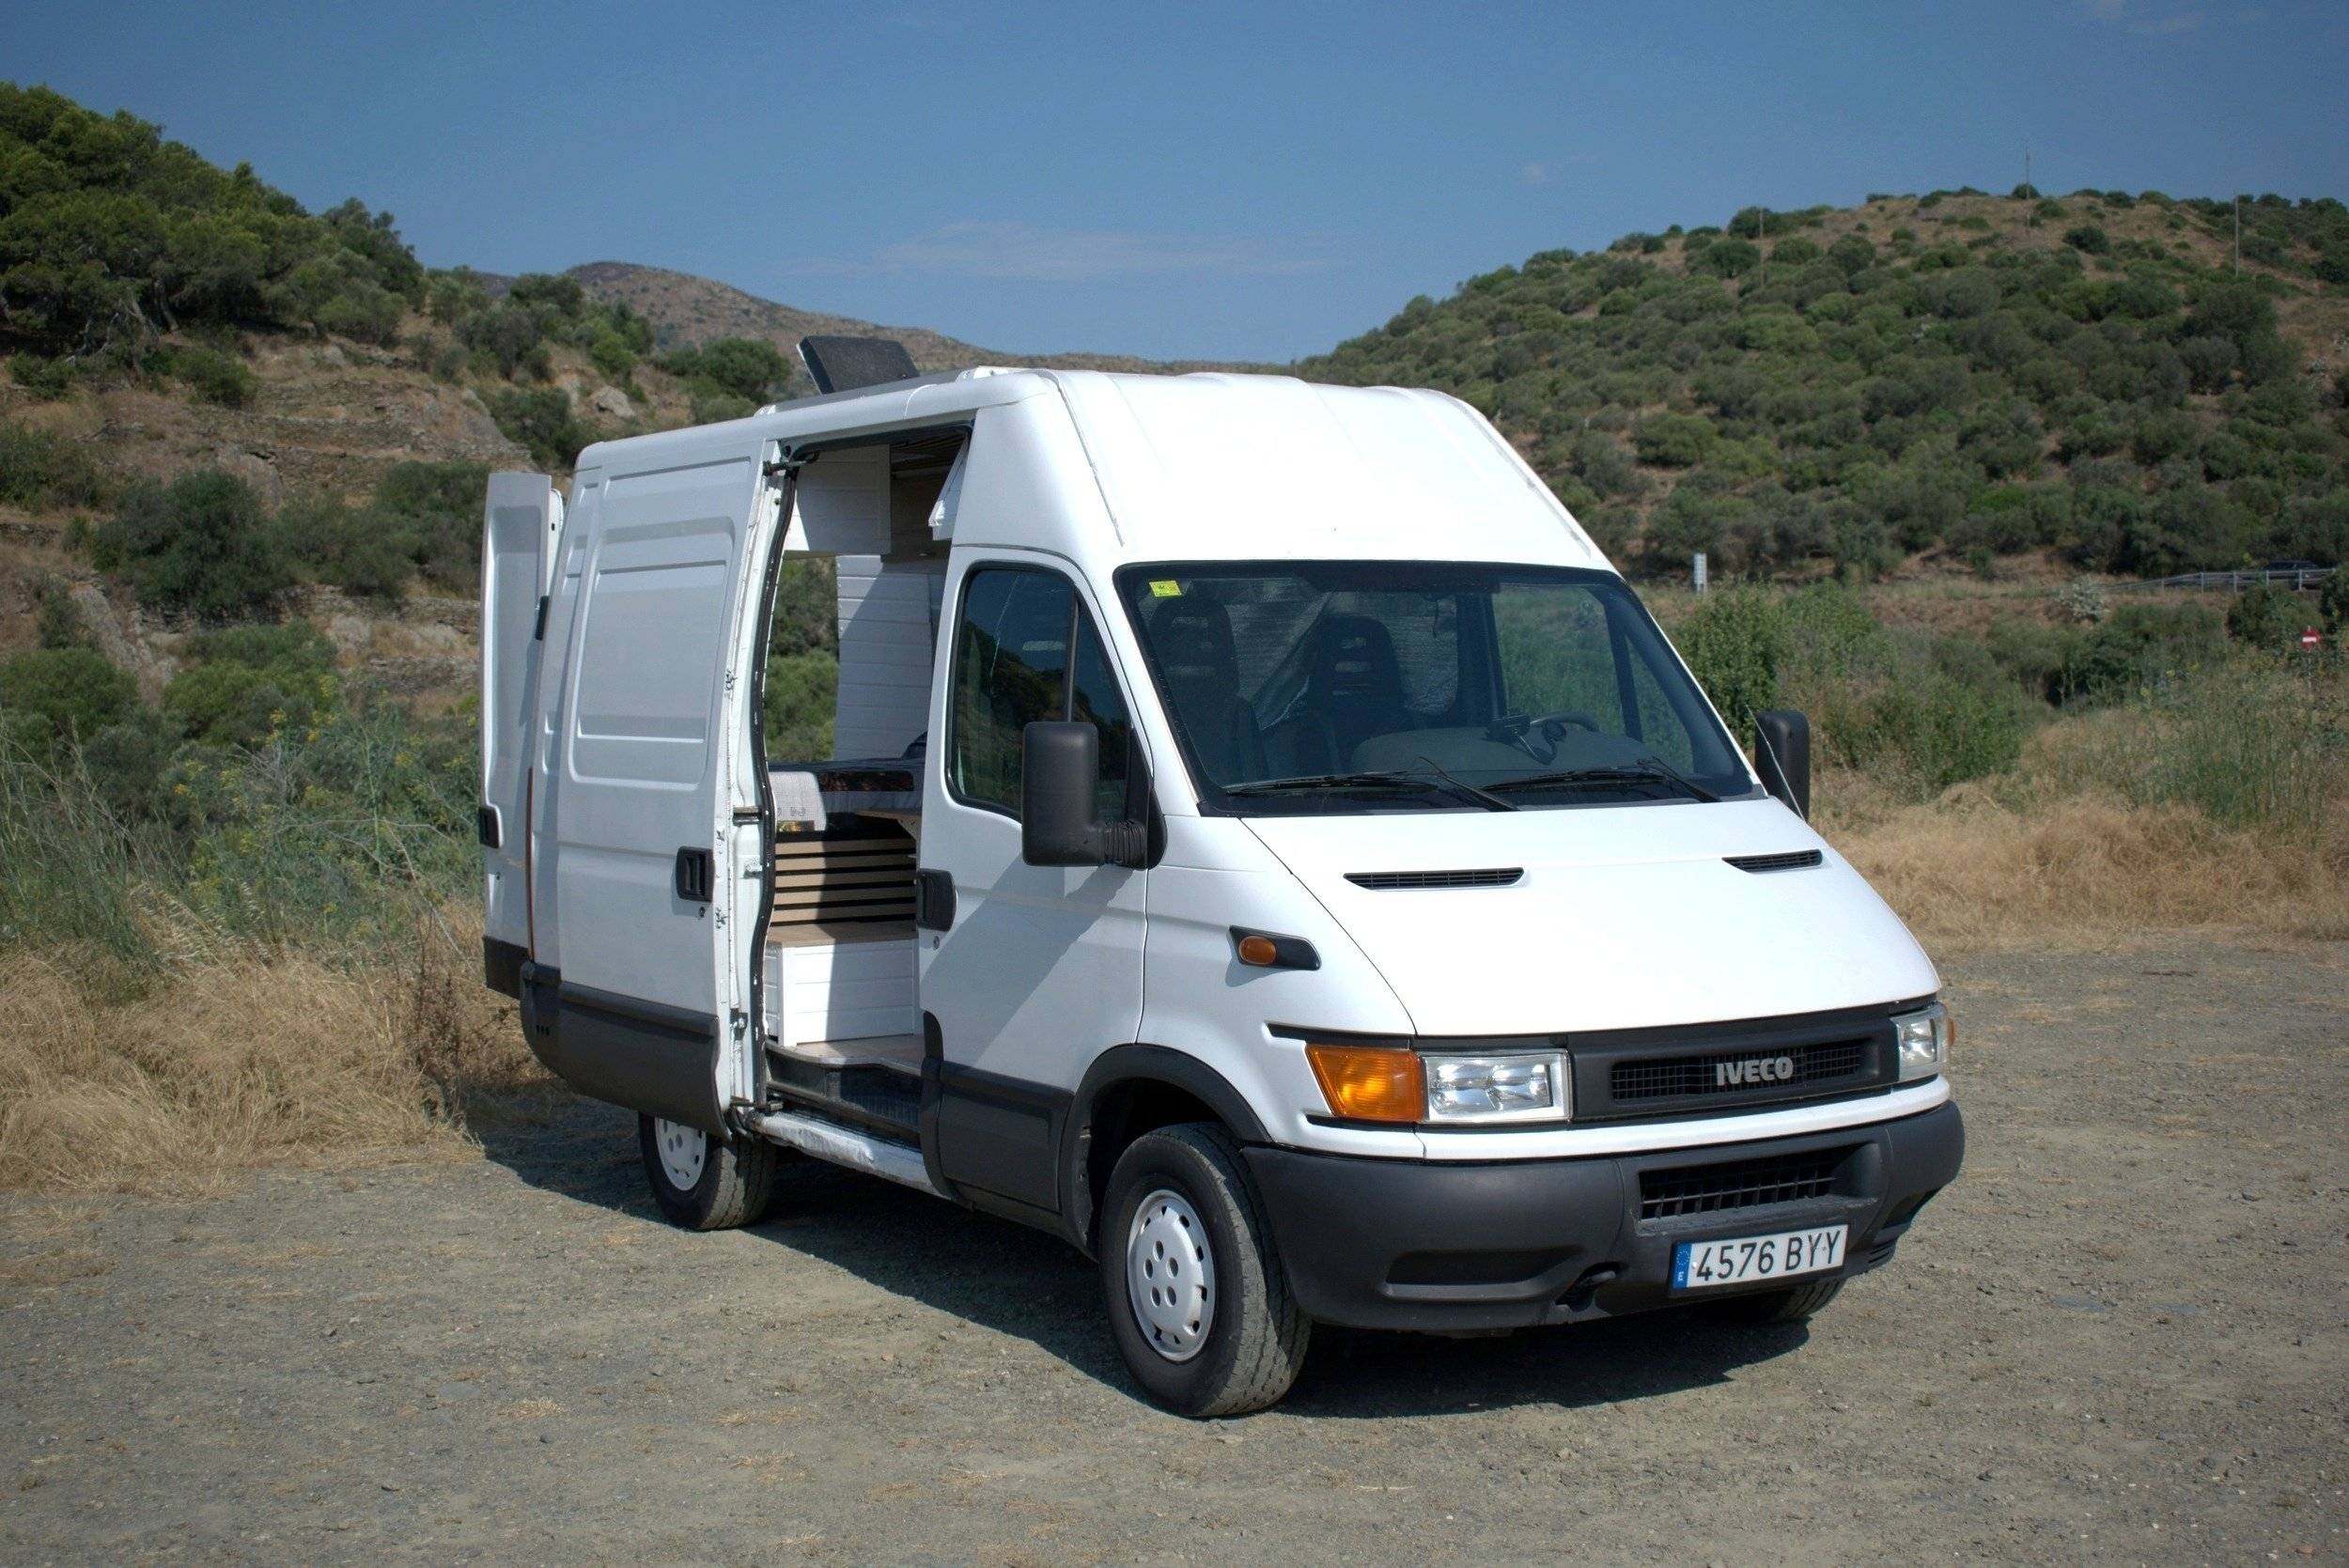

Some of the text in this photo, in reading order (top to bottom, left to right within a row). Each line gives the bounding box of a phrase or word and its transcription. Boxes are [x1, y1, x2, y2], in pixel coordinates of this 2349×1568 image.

[1716, 1056, 1794, 1086] IVECO
[1696, 1230, 1841, 1281] 4576 BYY
[1677, 1271, 1684, 1281] E
